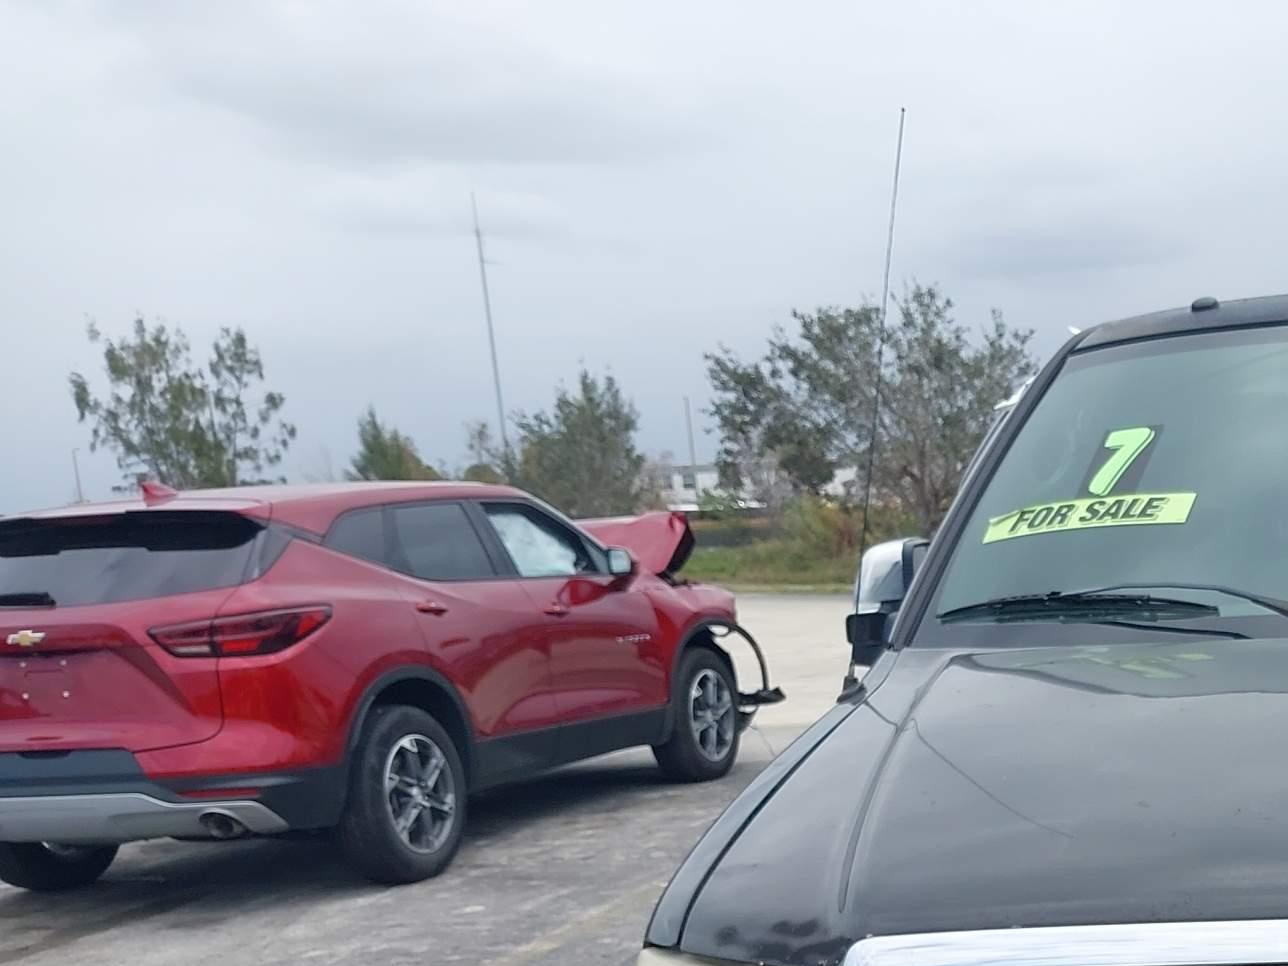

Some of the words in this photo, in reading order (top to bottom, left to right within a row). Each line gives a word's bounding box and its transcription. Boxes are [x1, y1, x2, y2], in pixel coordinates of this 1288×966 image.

[1088, 427, 1155, 496] 7
[1009, 504, 1077, 534] FOR
[1079, 497, 1169, 523] SALE
